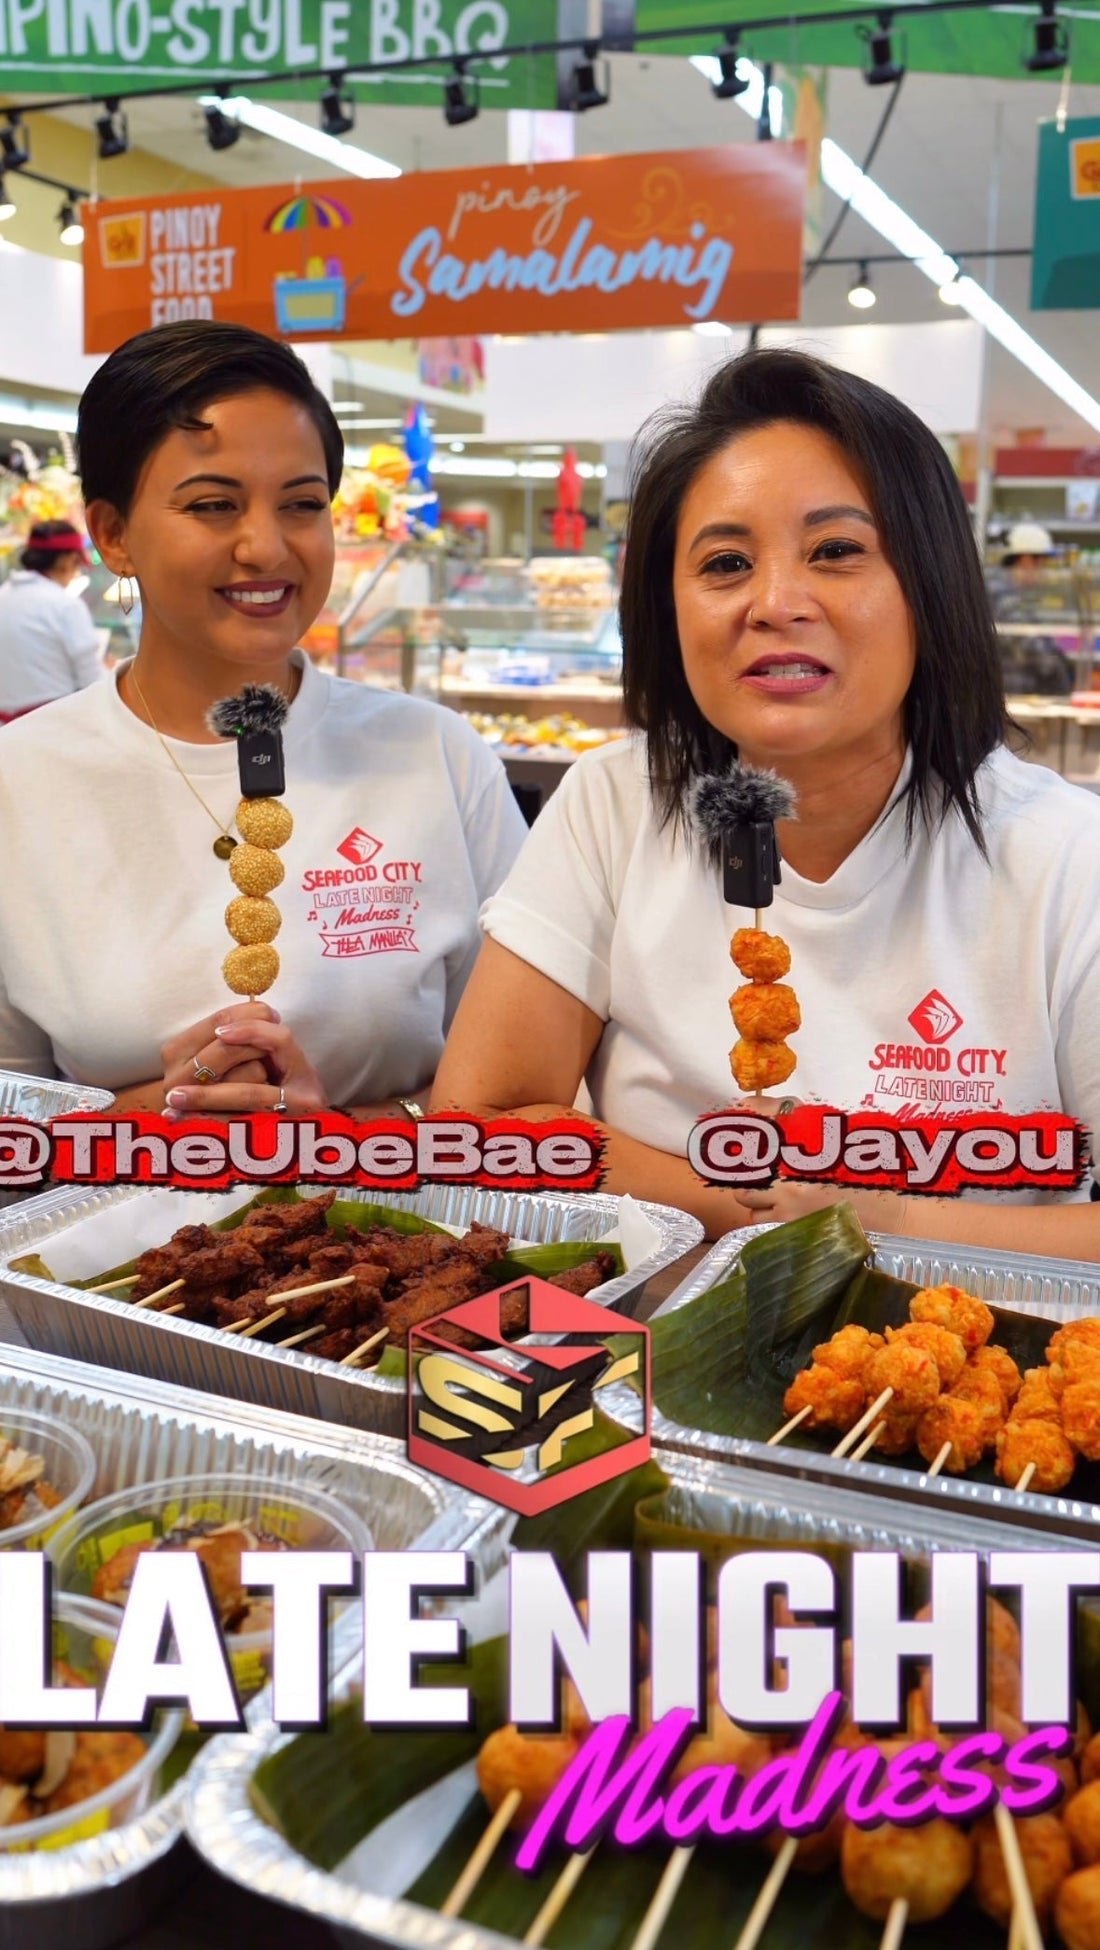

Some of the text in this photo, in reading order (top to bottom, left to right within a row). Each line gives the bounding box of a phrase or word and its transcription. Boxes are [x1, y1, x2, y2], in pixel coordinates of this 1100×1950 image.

[0, 0, 510, 70] PINO-STYLE BBQ
[151, 203, 222, 250] PINOY
[447, 181, 582, 247] pinoy
[151, 246, 236, 295] STREET
[389, 216, 735, 318] Samalamig
[302, 862, 423, 892] SEAFOOD CITY
[313, 885, 414, 909] LATE NIGHT
[334, 904, 401, 930] Madness
[868, 1043, 1008, 1077] SEAFOOD CITY
[875, 1074, 995, 1103] LATE NIGHT
